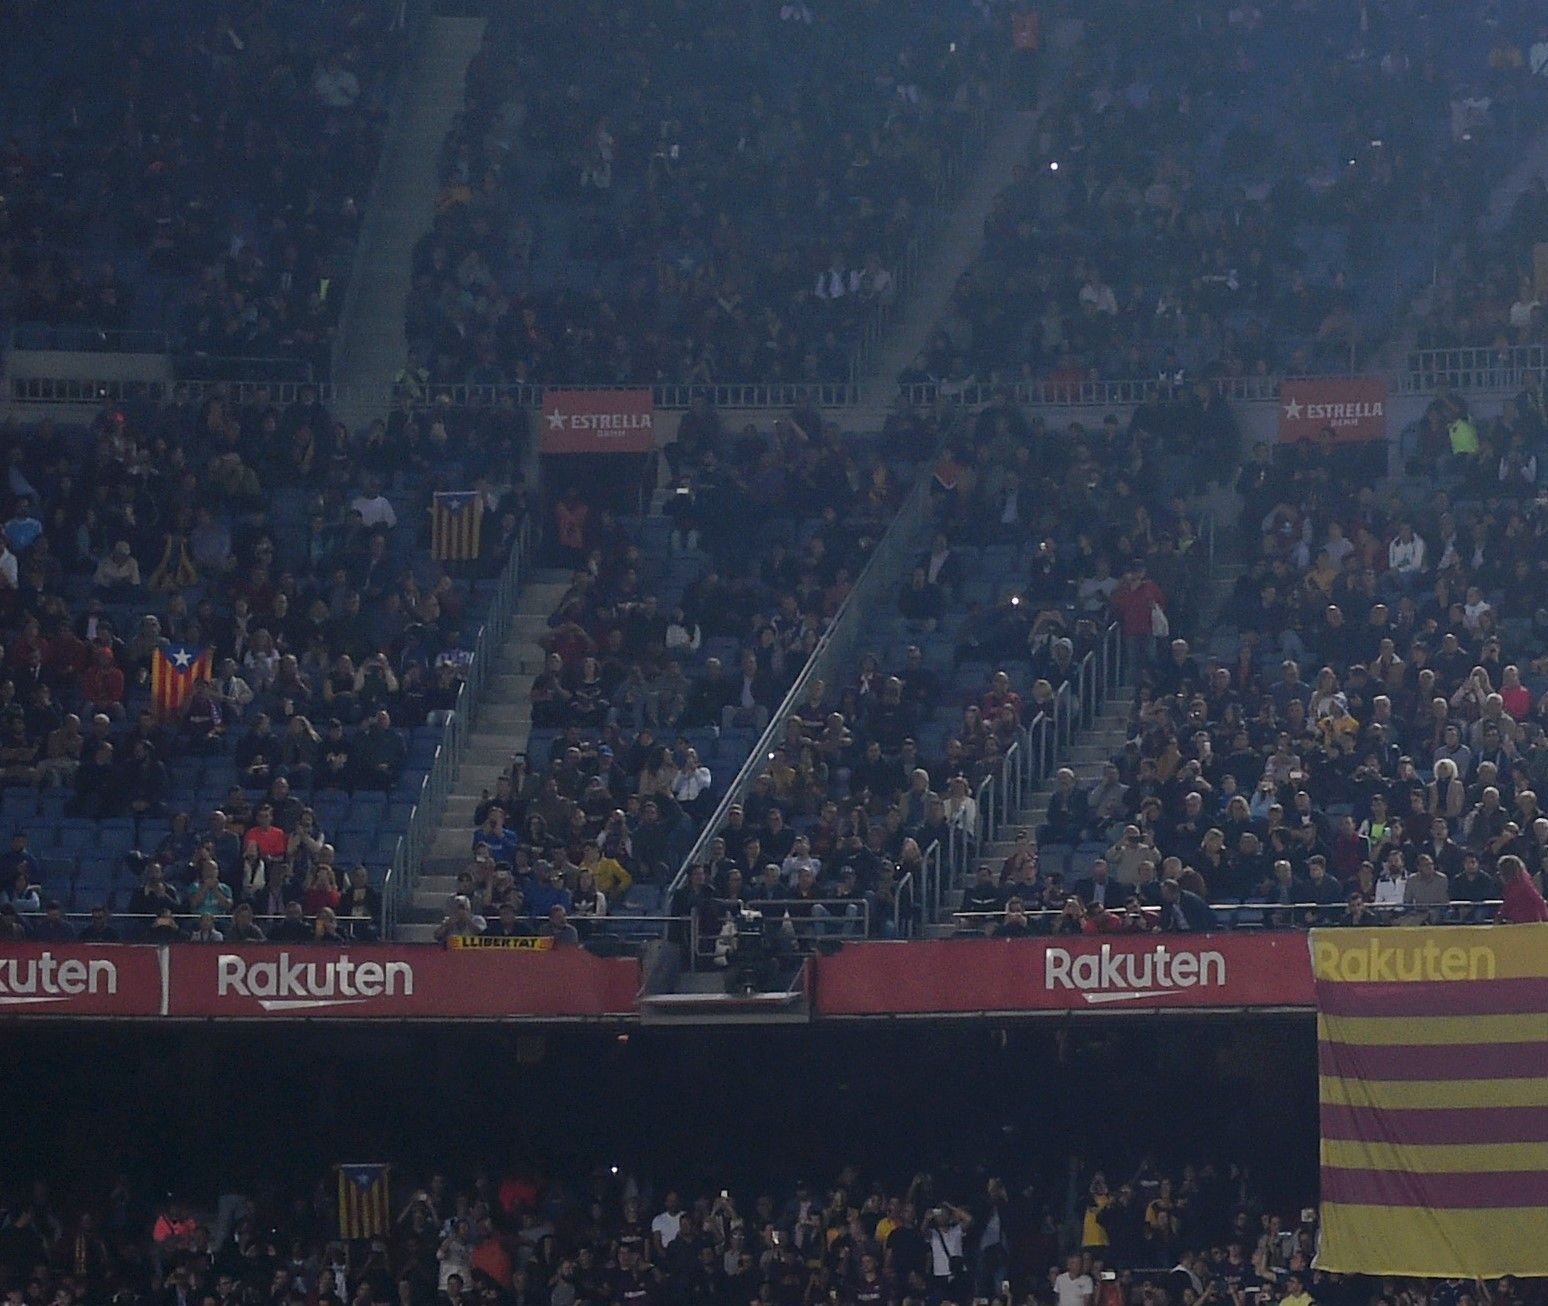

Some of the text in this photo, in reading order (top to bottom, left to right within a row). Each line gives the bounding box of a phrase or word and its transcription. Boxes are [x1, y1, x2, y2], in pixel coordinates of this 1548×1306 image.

[572, 414, 652, 429] ESTRELLA
[1307, 402, 1383, 418] ESTRELLA
[462, 937, 538, 948] LLIBERTAT
[1045, 944, 1225, 988] Rakuten
[1314, 938, 1495, 981] Rakuten
[218, 953, 413, 996] Rakuten
